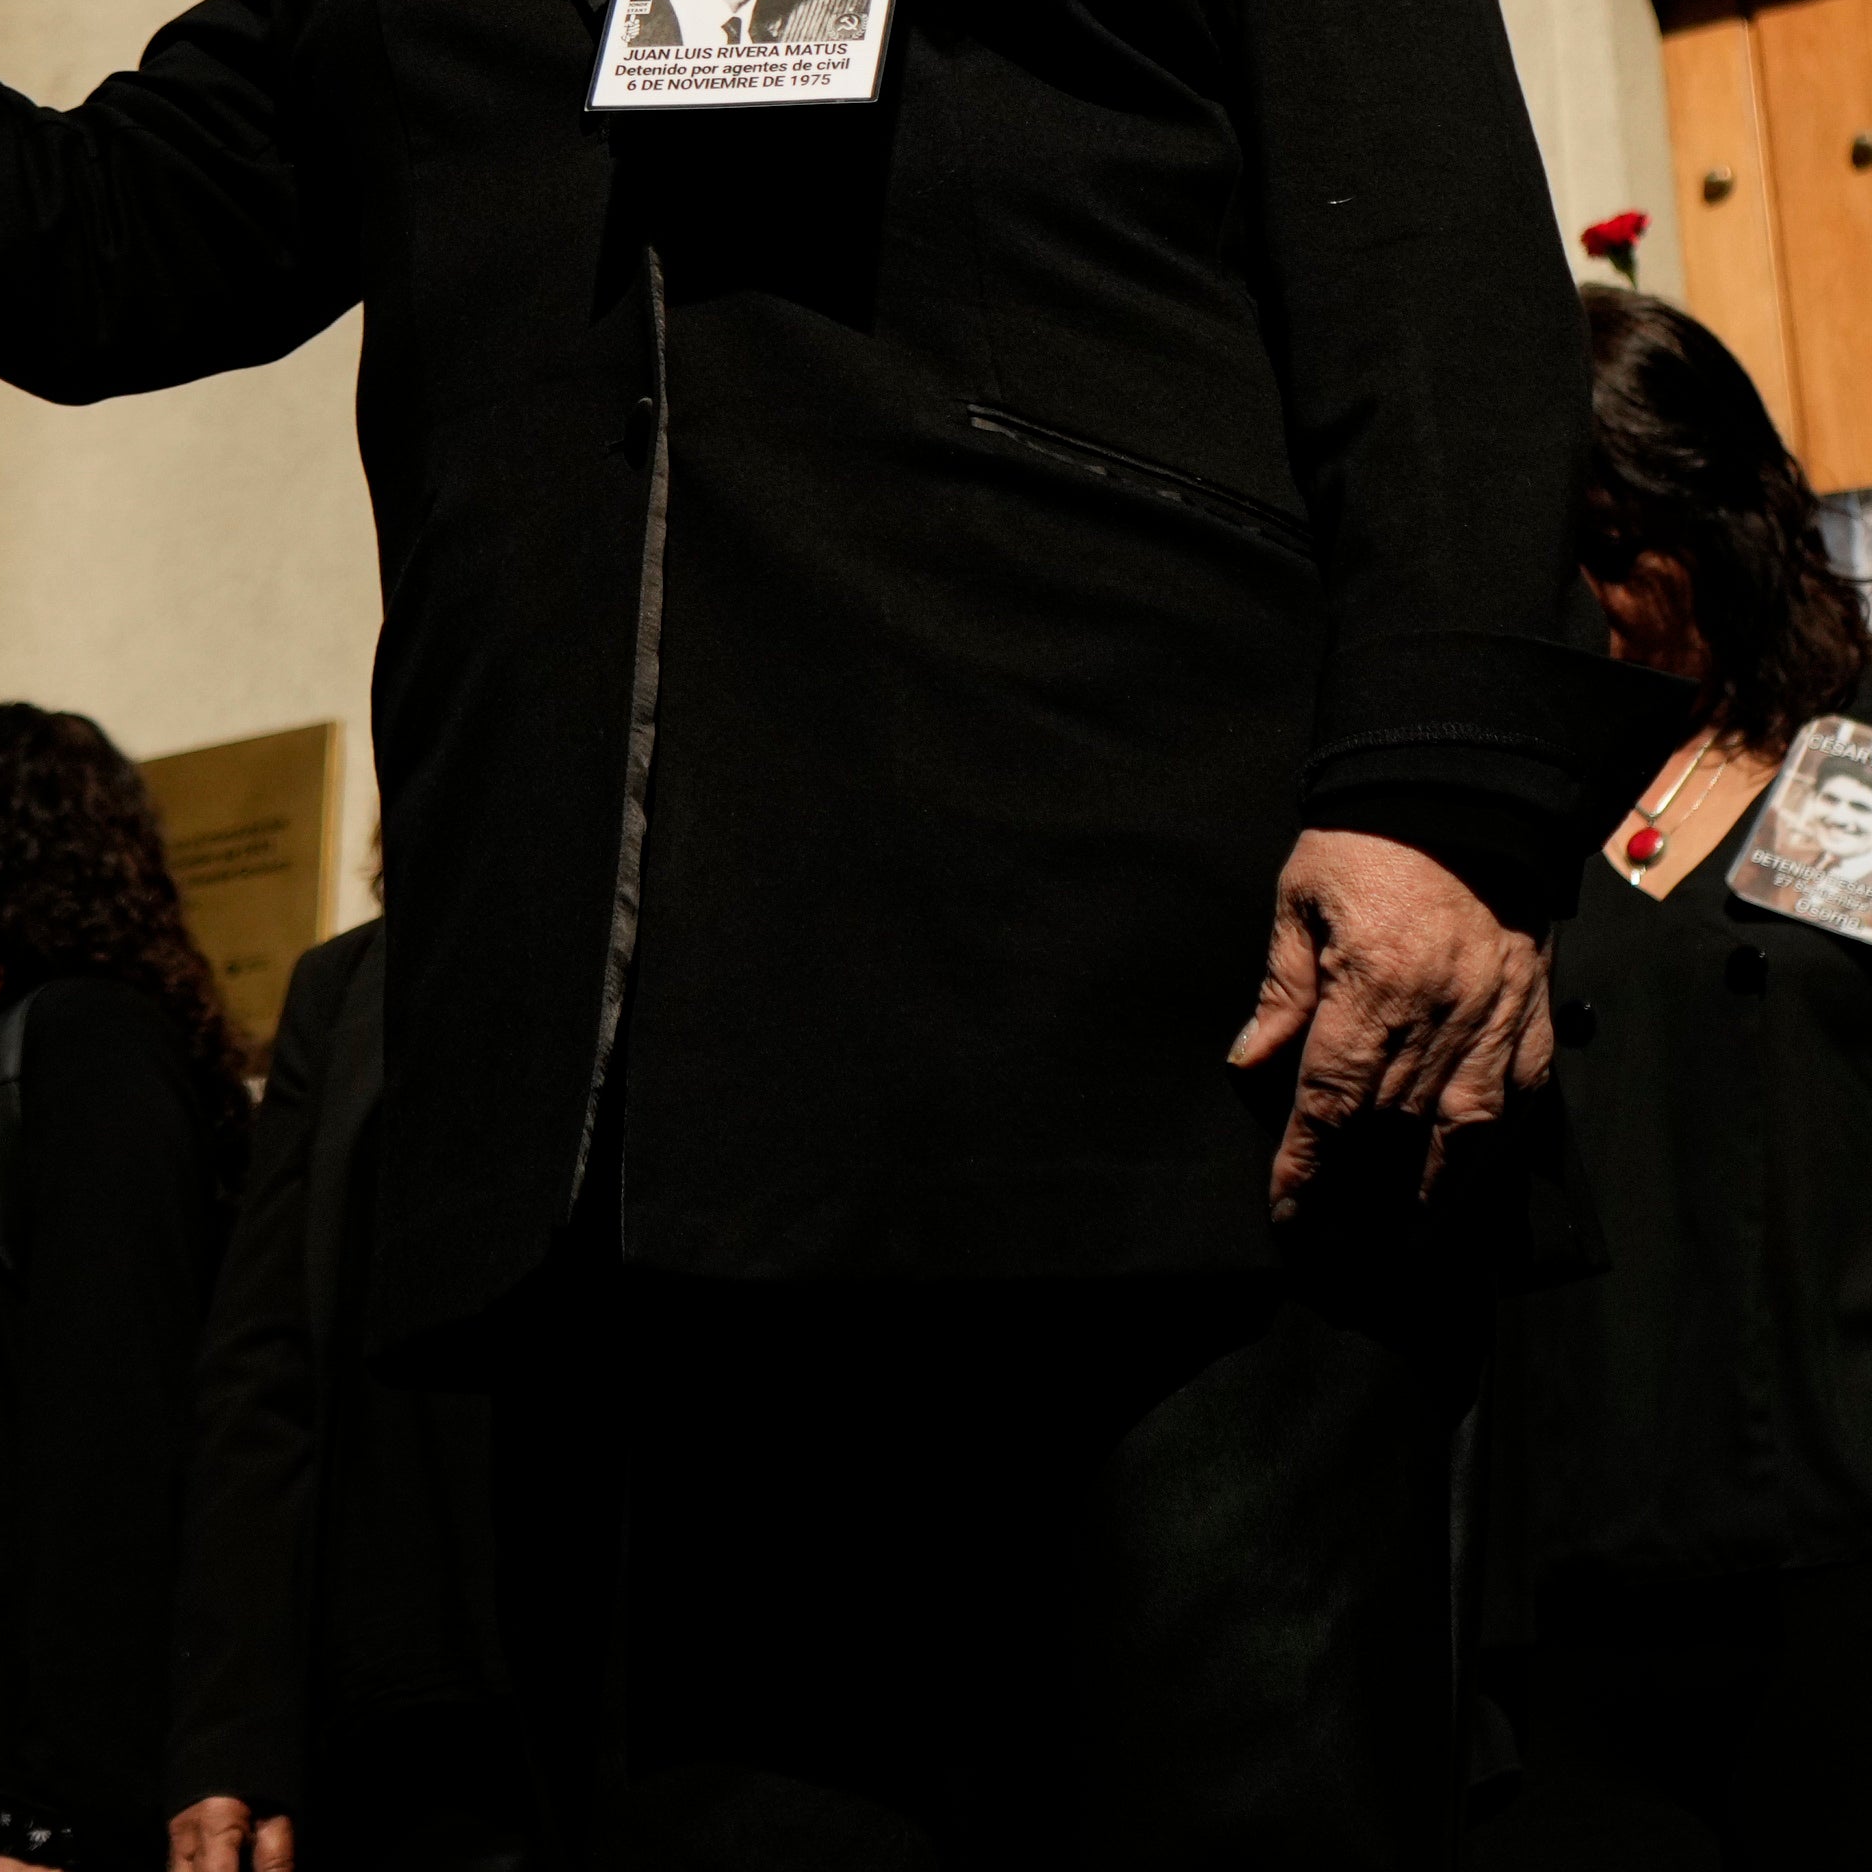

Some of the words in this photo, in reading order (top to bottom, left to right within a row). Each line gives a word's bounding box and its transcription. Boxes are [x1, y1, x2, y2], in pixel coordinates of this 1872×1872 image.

[623, 48, 671, 61] JUAN
[674, 47, 713, 60] LUIS
[716, 45, 779, 59] RIVERA
[784, 43, 848, 57] MATUS
[614, 62, 687, 77] Detenido
[691, 64, 719, 78] por
[722, 61, 788, 78] agentes
[791, 59, 812, 72] de
[816, 58, 850, 71] civil
[627, 79, 637, 92] 6
[641, 78, 664, 91] DE
[667, 76, 759, 91] NOVIEMRE
[762, 75, 784, 88] DE
[791, 73, 832, 87] 1975
[1751, 849, 1826, 883] DETENIDO
